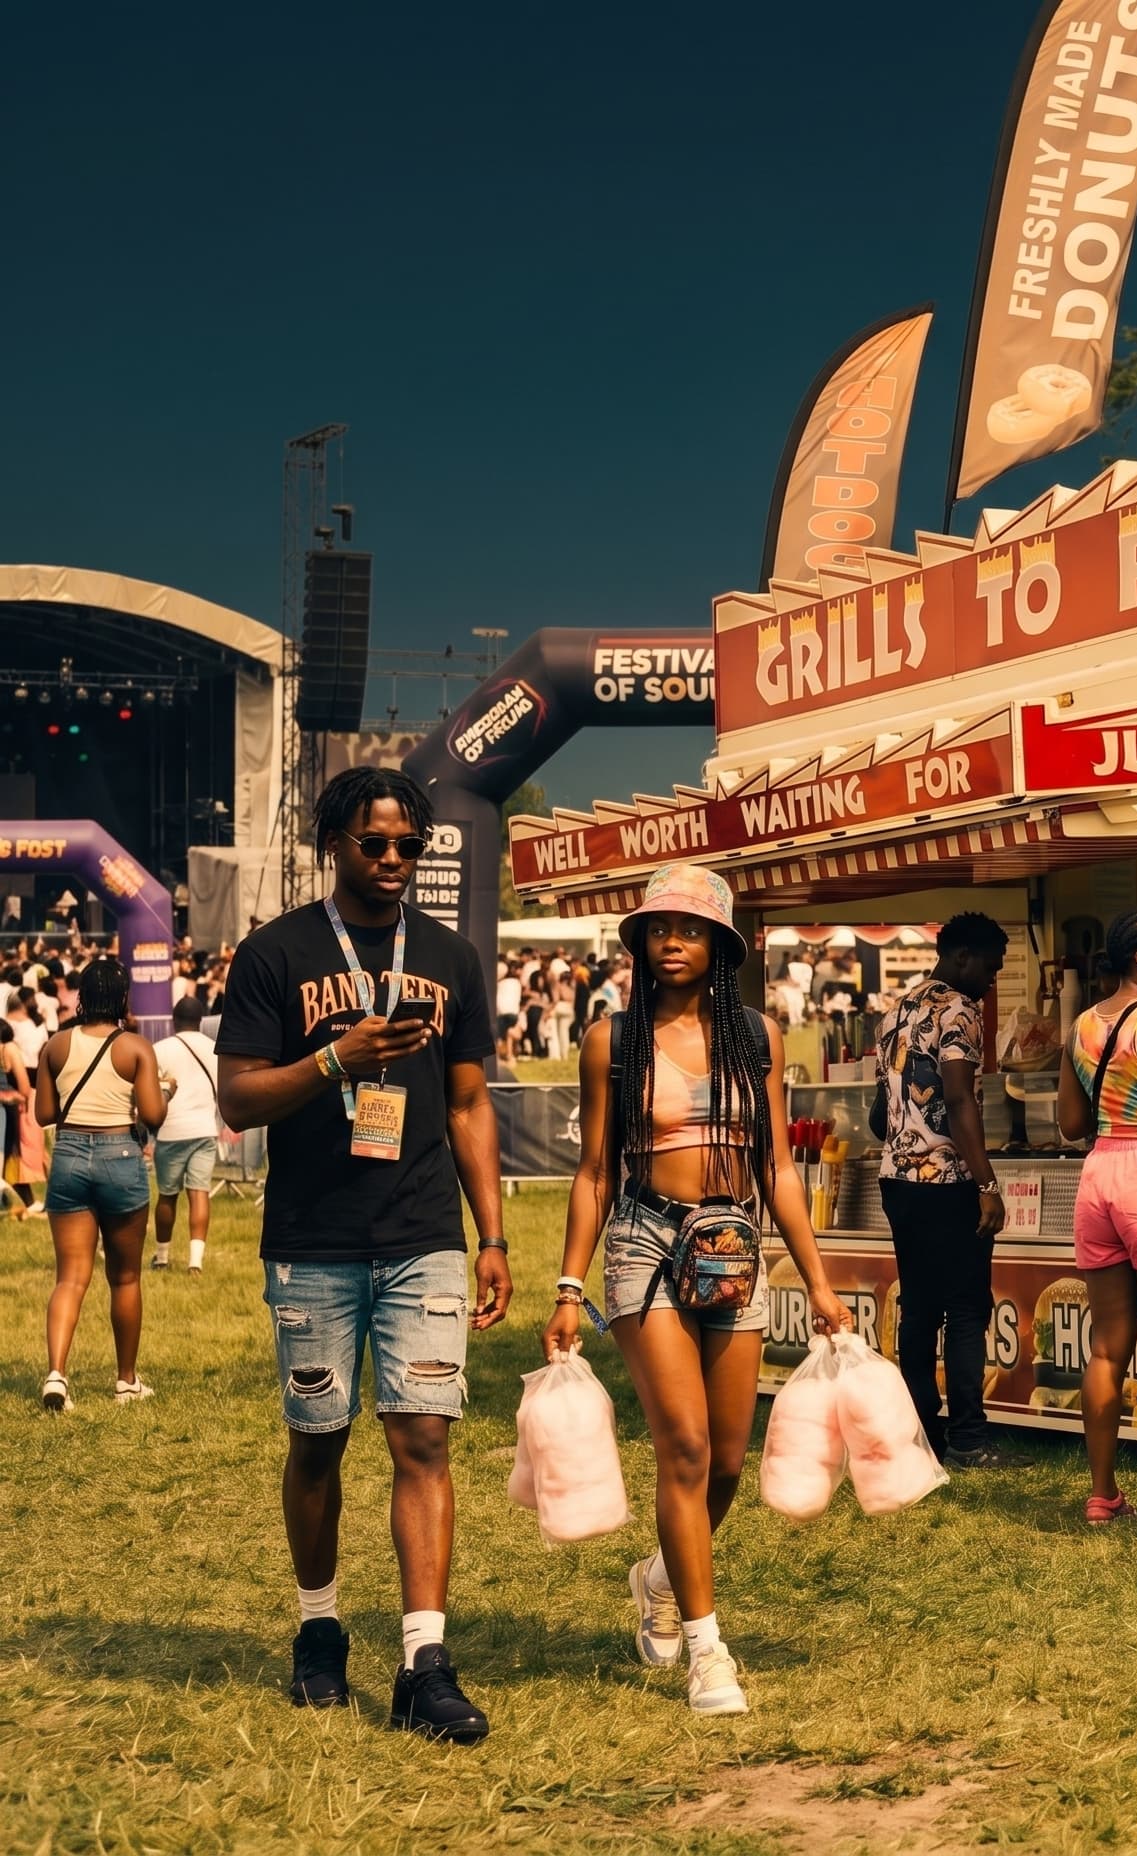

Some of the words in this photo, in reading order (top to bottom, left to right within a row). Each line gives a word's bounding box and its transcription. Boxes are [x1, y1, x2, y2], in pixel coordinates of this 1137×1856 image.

[1008, 138, 1071, 320] FRESHLY
[1043, 21, 1102, 130] MADE
[594, 677, 636, 702] OF
[755, 574, 927, 706] GRILLS
[976, 533, 1062, 648] TO
[534, 832, 591, 875] WELL
[619, 809, 710, 860] WORTH
[740, 778, 867, 838] WAITING
[904, 751, 972, 805] FOR
